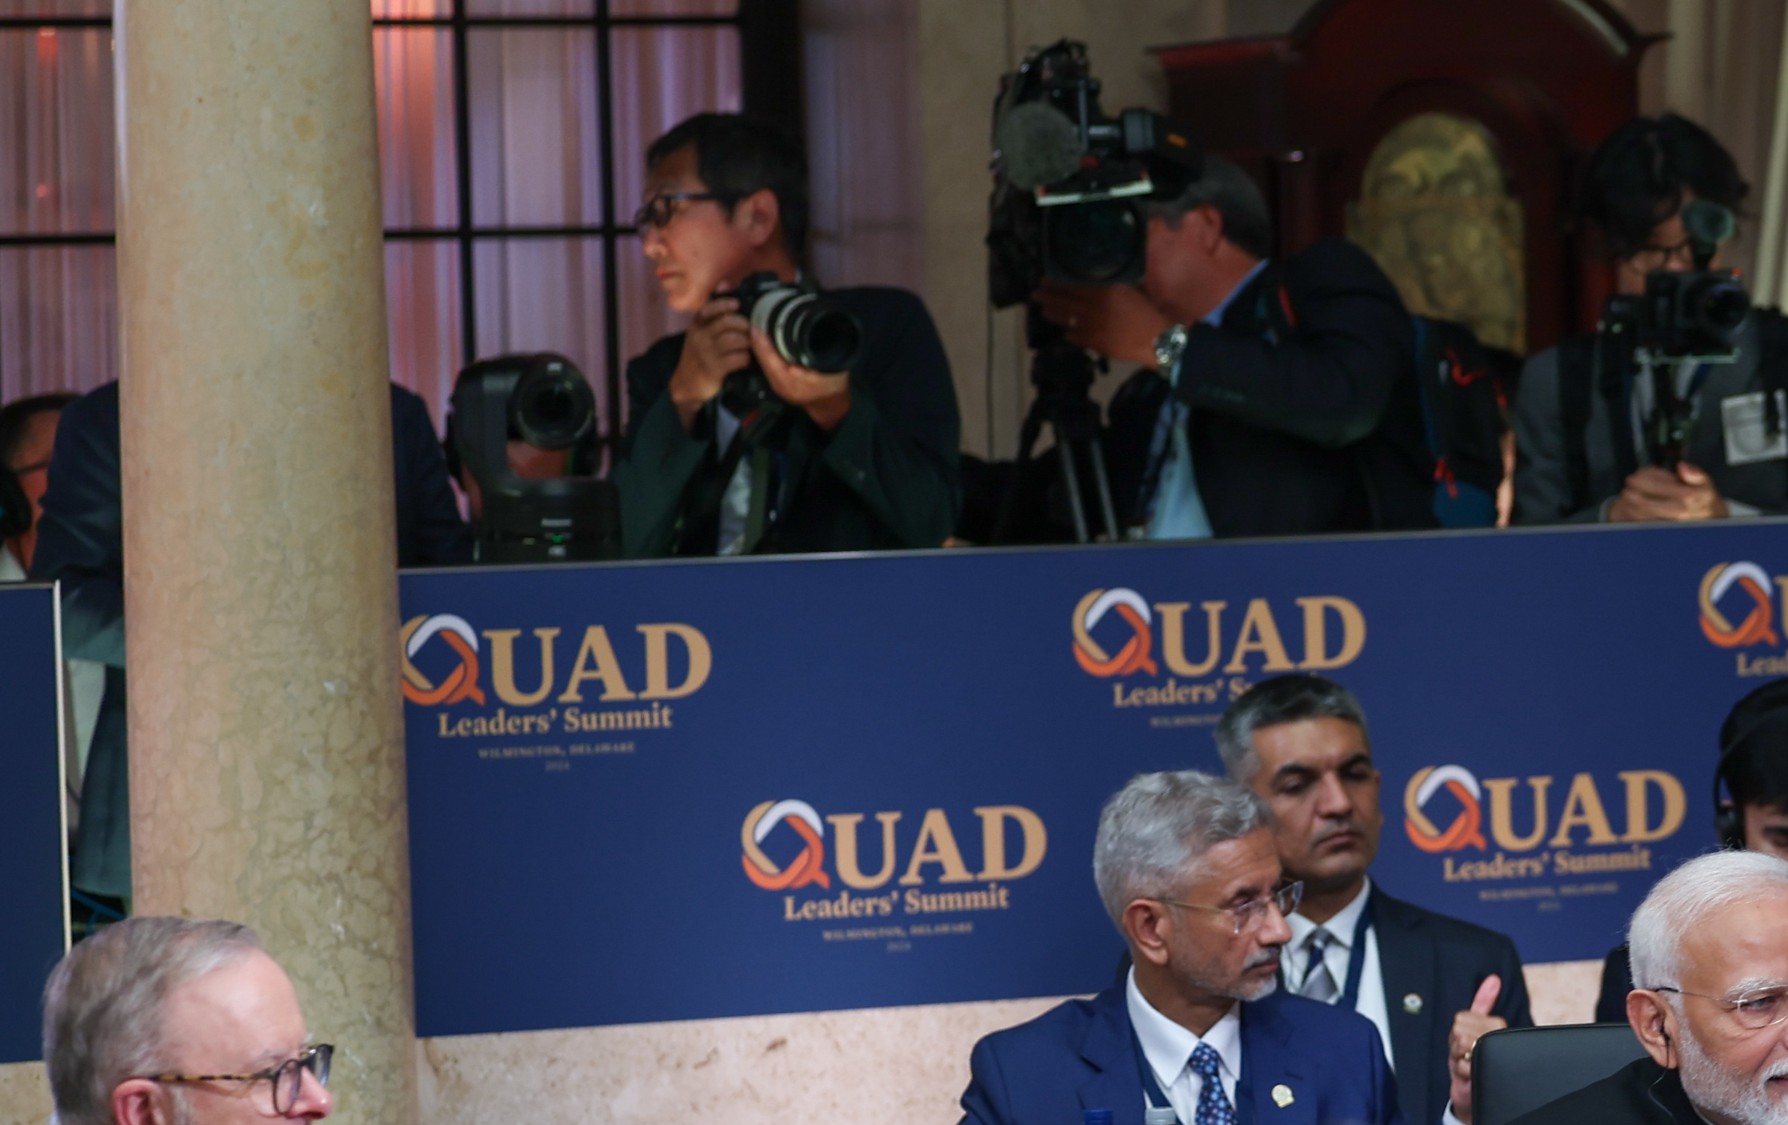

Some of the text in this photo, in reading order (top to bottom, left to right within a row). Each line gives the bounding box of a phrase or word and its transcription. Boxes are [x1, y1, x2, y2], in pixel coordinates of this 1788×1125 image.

[400, 613, 712, 706] QUAD
[1072, 587, 1366, 677] QUAD
[438, 701, 673, 737] Leaders' Summit
[1113, 678, 1223, 707] Leaders'
[1404, 764, 1687, 852] QUAD
[741, 799, 1048, 891] QUAD
[1443, 845, 1651, 882] Leaders' Summit
[784, 882, 1009, 921] Leaders' Summit
